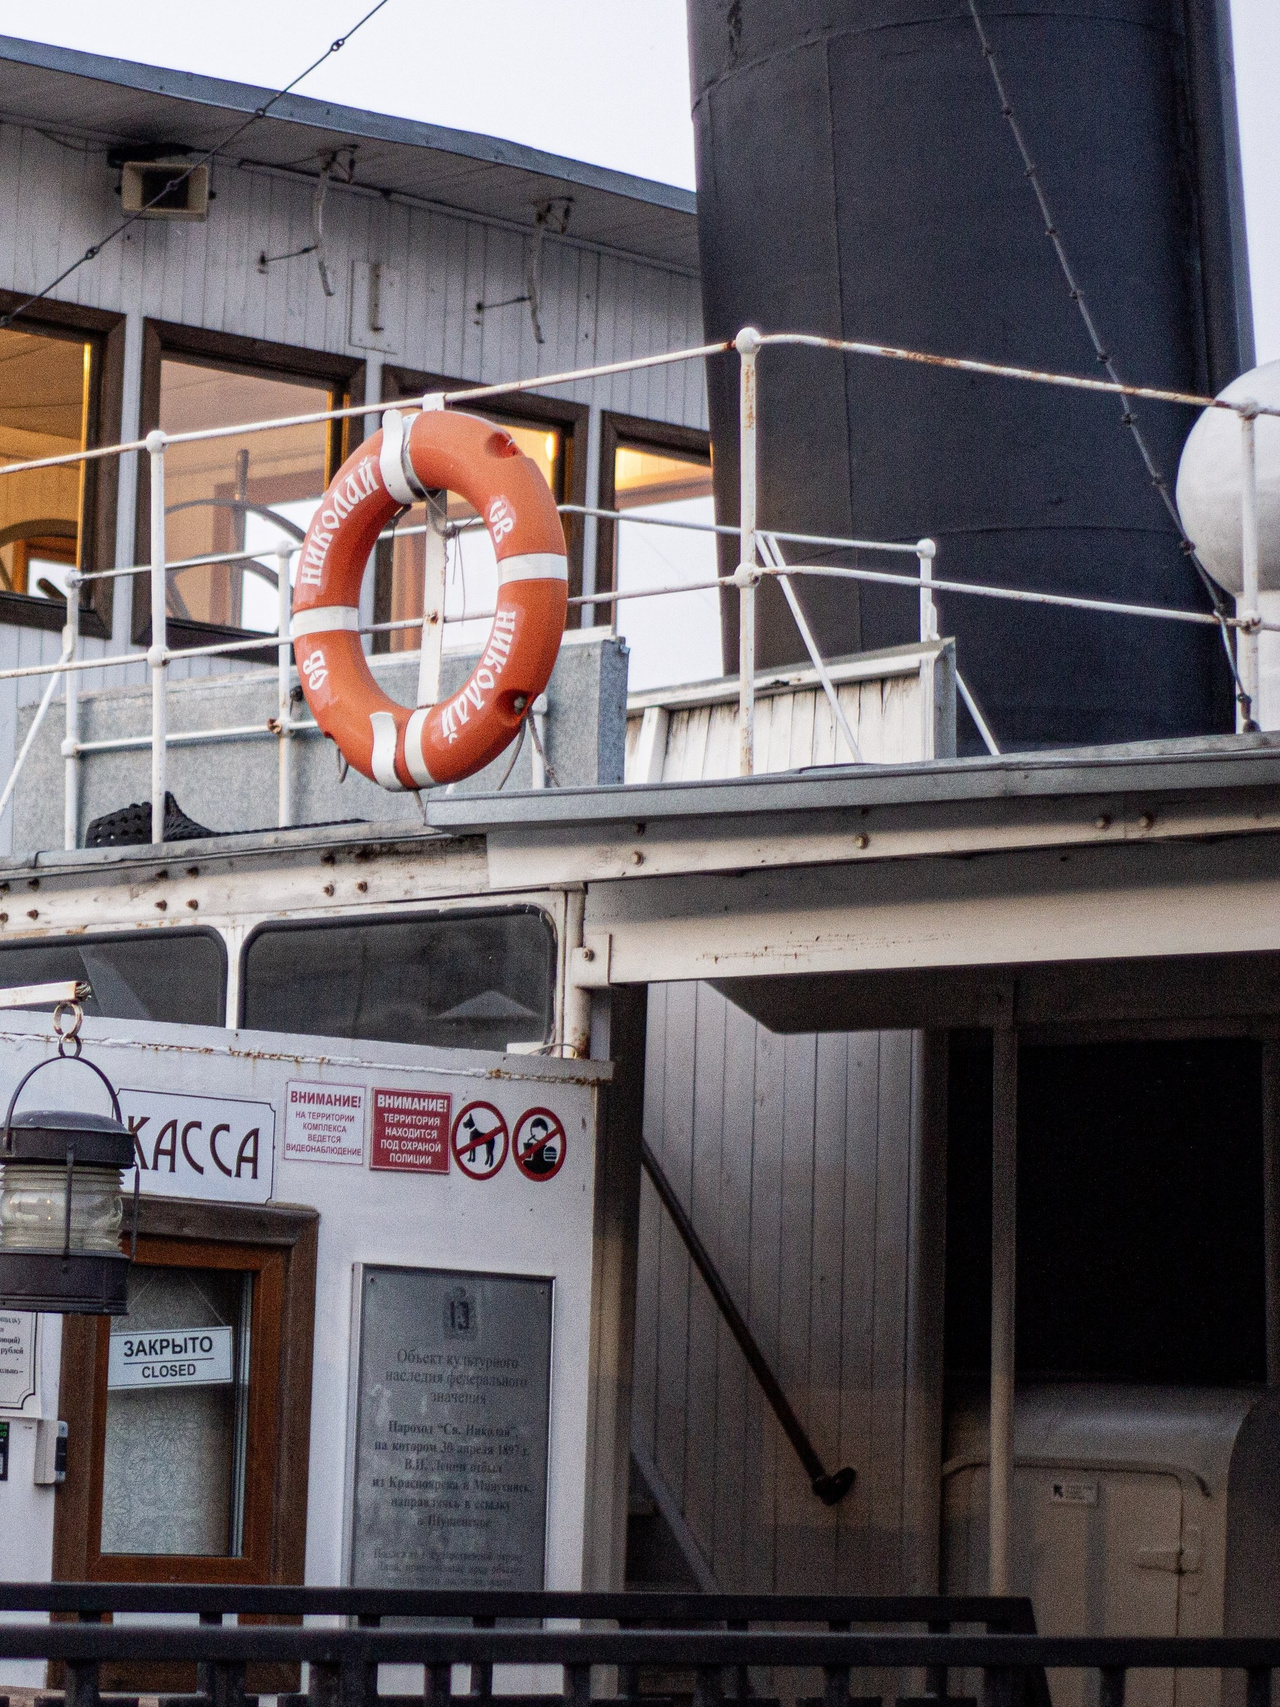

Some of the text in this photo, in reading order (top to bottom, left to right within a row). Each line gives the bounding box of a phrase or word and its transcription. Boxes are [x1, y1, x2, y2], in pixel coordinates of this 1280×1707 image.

[290, 1091, 361, 1108] ВНИМАНИЕ!
[377, 1094, 448, 1112] ВНИМАНИЕ!
[295, 1111, 355, 1122] НА ТЕРРИТОРИИ
[383, 1113, 440, 1126] ТЕРРИТОРИЯ
[302, 1122, 347, 1133] КОМПЛЕКСА
[385, 1127, 438, 1139] НАХОДИТСЯ
[308, 1135, 341, 1144] ВЕДЕТСЯ
[381, 1139, 441, 1153] ПОД ОХРАНОЙ
[128, 1115, 260, 1179] КАССА
[286, 1143, 362, 1156] ВИДЕОНАБЛЮДЕНИЕ
[389, 1153, 432, 1165] ПОЛИЦИИ
[123, 1336, 213, 1357] ЗАКРЫТО
[142, 1364, 196, 1379] CLOSED
